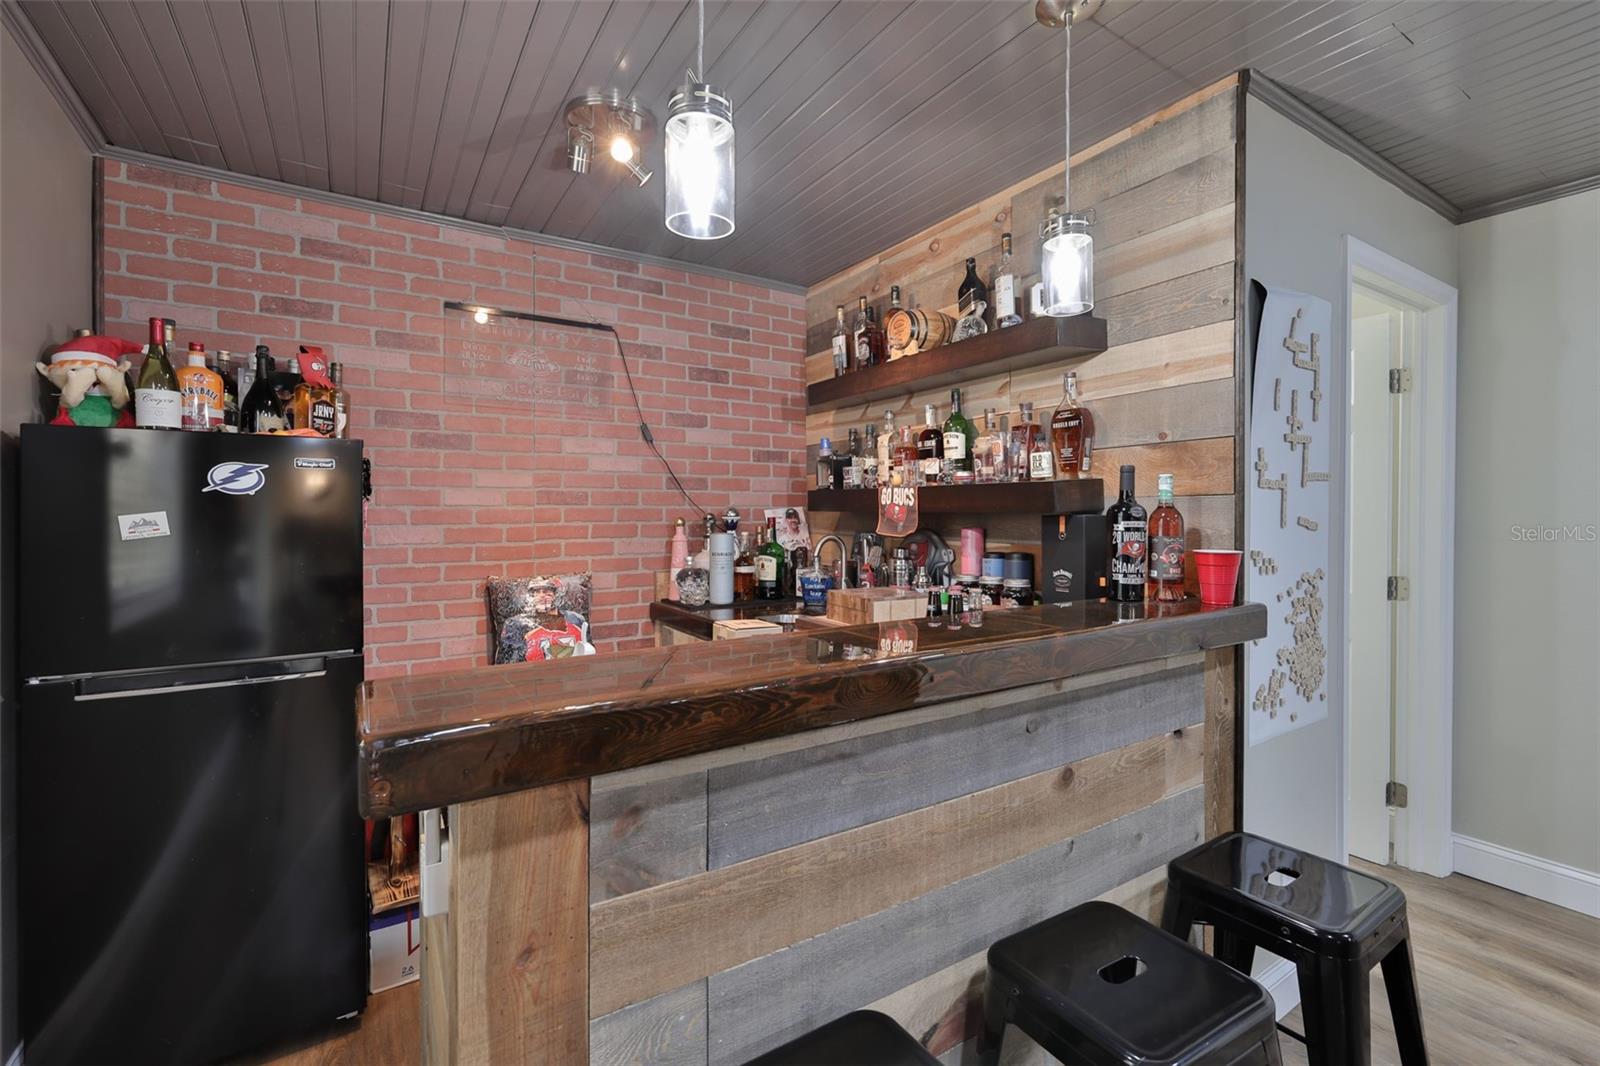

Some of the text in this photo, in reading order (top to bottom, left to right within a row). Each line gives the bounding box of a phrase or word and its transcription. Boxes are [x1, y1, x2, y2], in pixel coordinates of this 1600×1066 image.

[181, 387, 218, 400] FIREBALL
[313, 404, 334, 418] JRNY
[881, 487, 914, 506] GO BUCS
